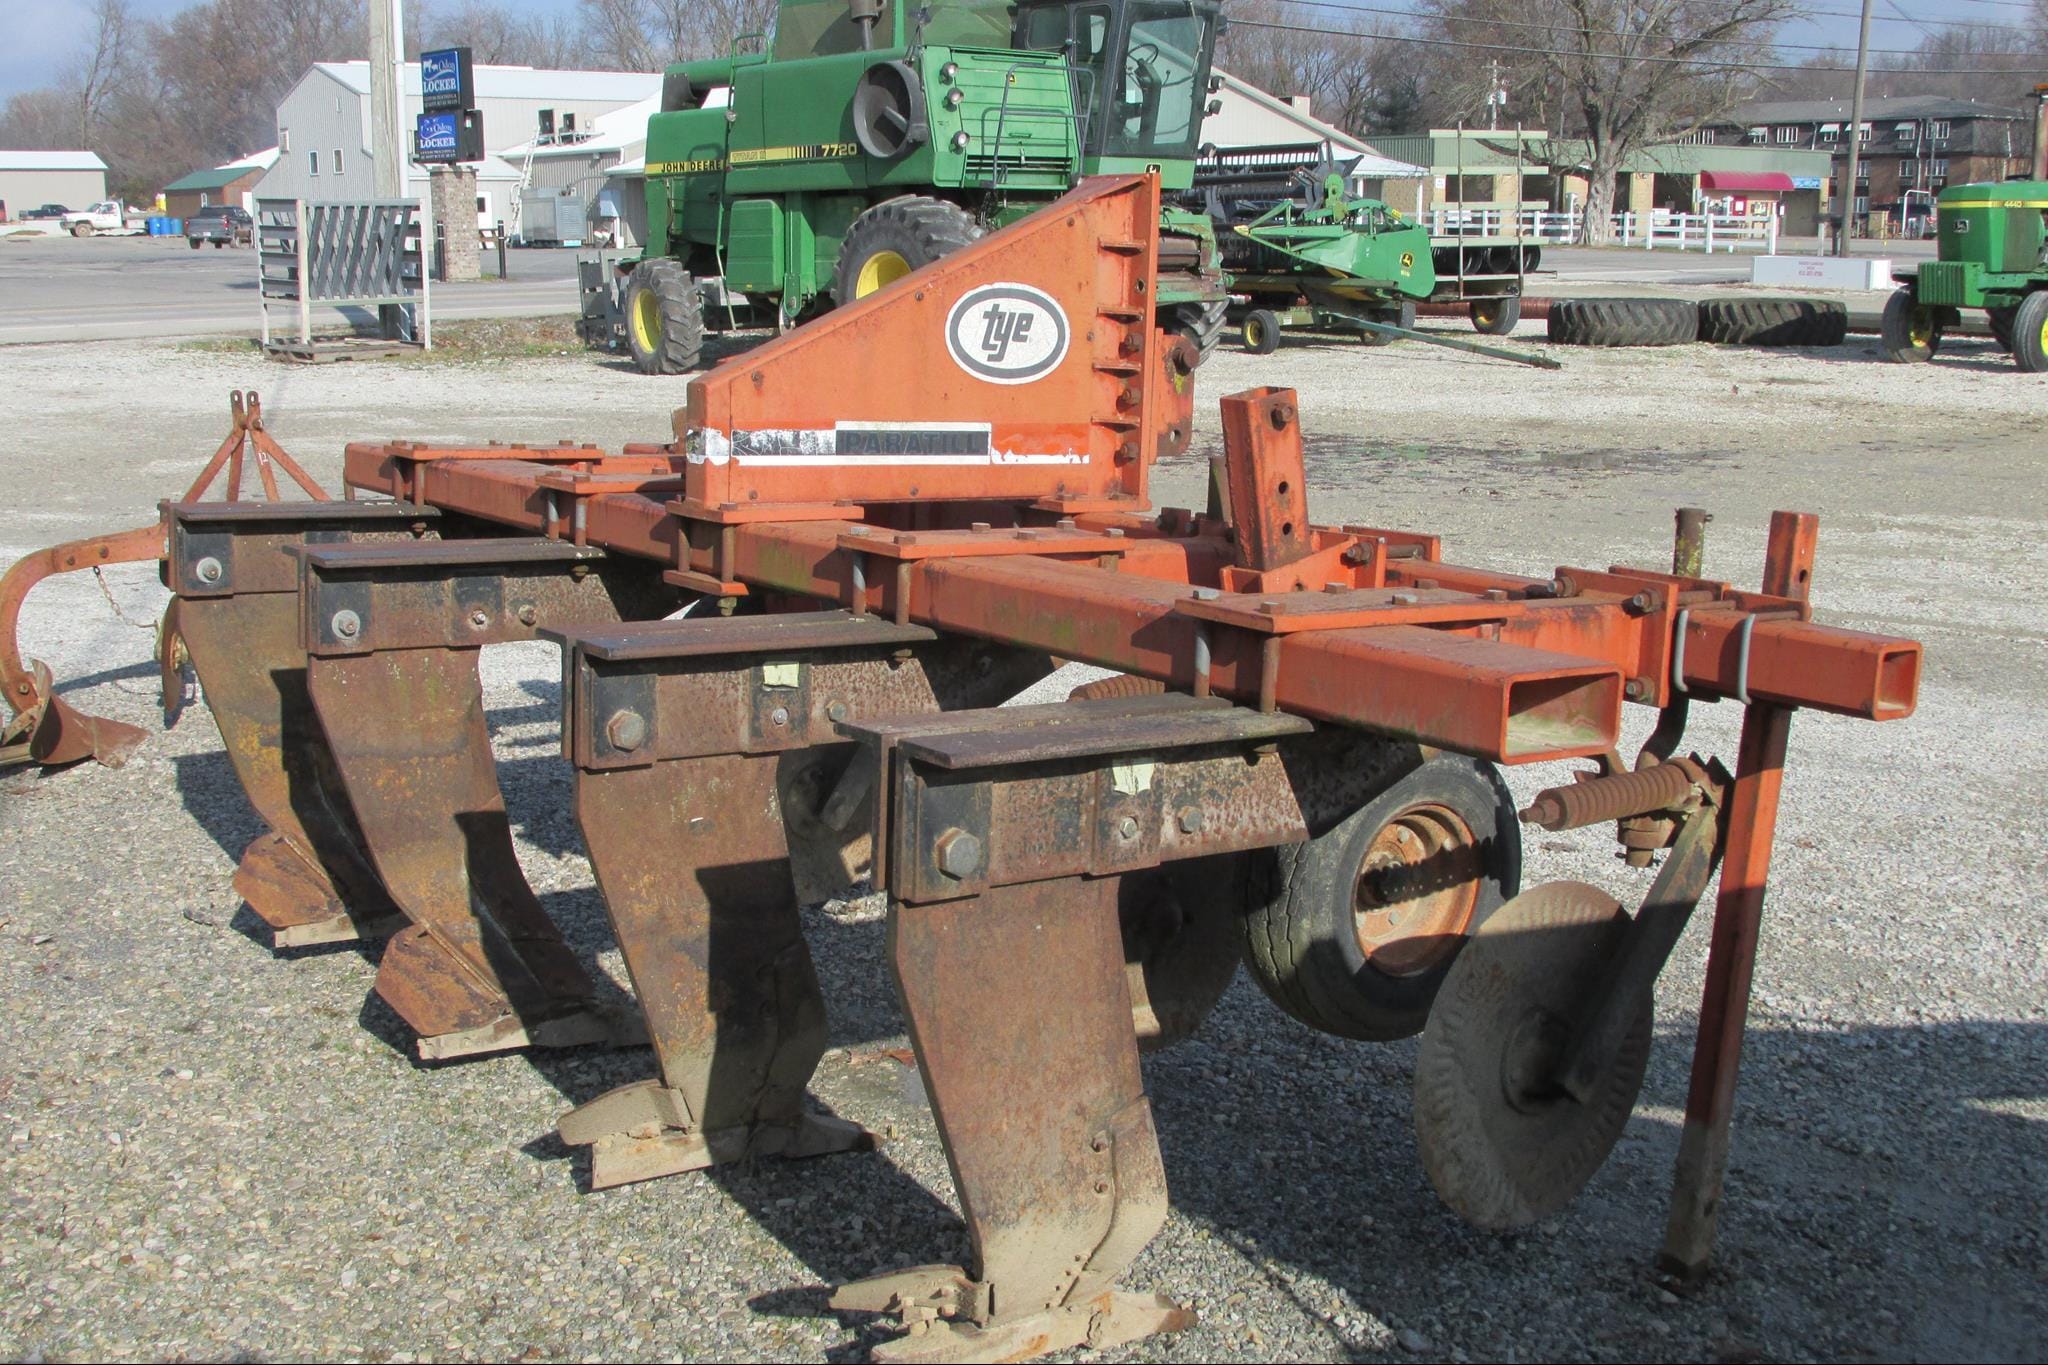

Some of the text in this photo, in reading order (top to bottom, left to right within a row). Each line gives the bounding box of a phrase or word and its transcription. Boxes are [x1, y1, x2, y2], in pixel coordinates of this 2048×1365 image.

[438, 59, 456, 71] Odon
[423, 78, 456, 93] LOCKER
[433, 122, 453, 134] Odon
[420, 137, 456, 149] LOCKER
[821, 143, 857, 157] 7720
[661, 160, 721, 173] JOHN DEERE
[981, 303, 1034, 362] tye
[845, 431, 982, 455] PARATILL
